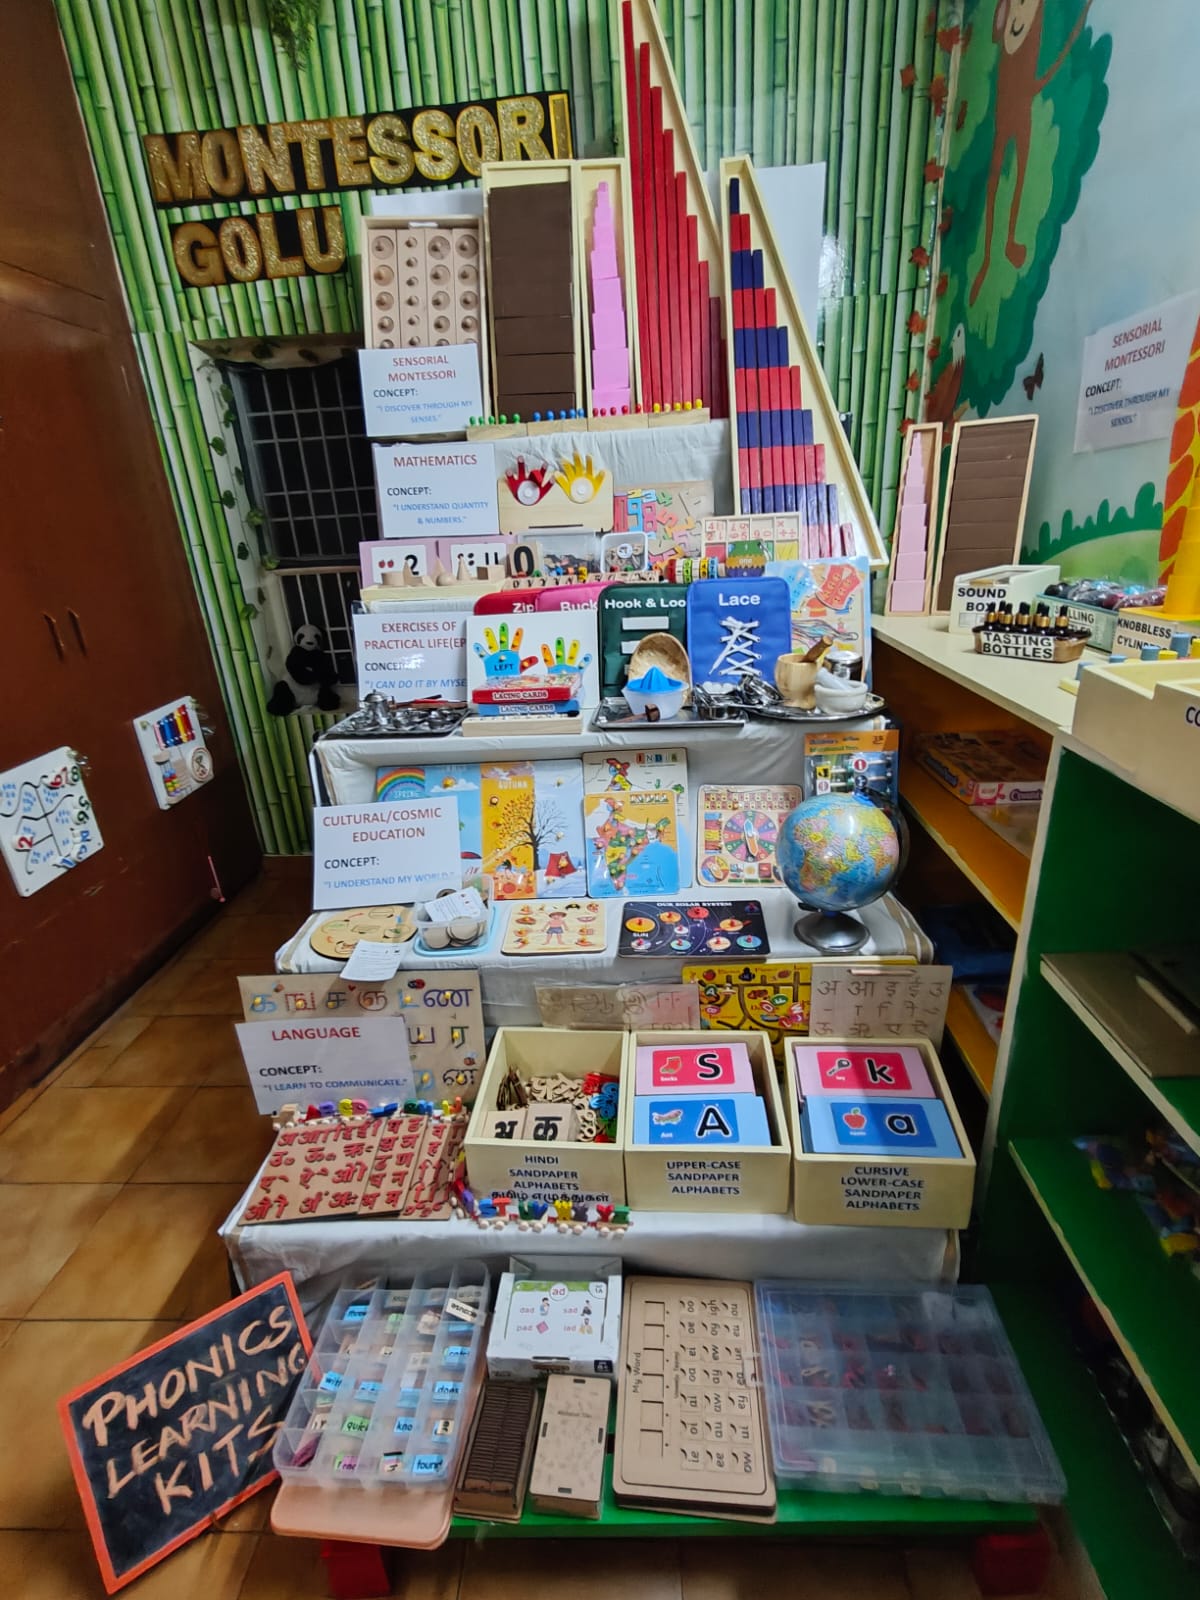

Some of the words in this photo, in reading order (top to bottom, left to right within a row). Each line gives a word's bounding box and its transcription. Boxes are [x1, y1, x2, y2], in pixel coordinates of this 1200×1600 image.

[144, 93, 571, 201] MONTESSORI
[173, 208, 346, 287] GOLU
[1111, 318, 1163, 348] SENSORIAL
[392, 353, 449, 367] SENSORIAL
[1104, 340, 1166, 371] MONTESSORI
[388, 369, 457, 382] MONTESSORI
[373, 388, 418, 398] CONCEPT:
[1085, 378, 1122, 398] CONCEPT:
[393, 454, 478, 467] MATHEMATICS
[387, 486, 432, 496] CONCEPT:
[401, 502, 450, 511] UNDERSTAND
[451, 501, 488, 511] QUANTITY
[405, 554, 420, 576] 2
[513, 546, 534, 578] 0
[957, 587, 1006, 598] SOUND
[560, 599, 598, 611] Buck
[604, 599, 641, 609] Hook
[645, 598, 657, 608] &
[661, 598, 685, 608] Loo
[718, 592, 761, 607] Lace
[512, 602, 535, 613] Zip
[966, 602, 991, 612] BOX
[381, 622, 439, 633] EXERCISES
[442, 621, 457, 632] OF
[1117, 617, 1172, 639] KNOBBLESS
[364, 639, 425, 650] PRACTICAL
[427, 637, 466, 649] LIFE(EP
[983, 631, 1053, 647] TASTING
[982, 643, 1053, 659] BOTTLES
[365, 661, 406, 671] CONCE
[494, 663, 514, 671] LEFT
[375, 680, 396, 689] CAN
[398, 679, 412, 689] DO
[415, 679, 423, 688] IT
[426, 679, 436, 688] BY
[440, 678, 466, 688] MYSE
[322, 807, 442, 827] CULTURAL/COSMIC
[352, 827, 425, 843] EDUCATION
[324, 856, 380, 870] CONCEPT:
[332, 874, 396, 889] UNDERSTAND
[397, 874, 413, 885] MY
[817, 980, 841, 996] अ
[848, 980, 875, 997] आ
[250, 992, 278, 1013] க
[325, 991, 347, 1009] ச
[271, 1026, 360, 1041] LANGUAGE
[259, 1065, 323, 1078] CONCEPT:
[698, 1052, 722, 1080] S
[866, 1058, 894, 1083] k
[275, 1081, 307, 1091] LEARN
[309, 1080, 323, 1089] TO
[533, 1116, 563, 1141] क
[697, 1106, 731, 1138] A
[888, 1115, 916, 1135] a
[524, 1155, 559, 1164] HINDI
[666, 1160, 742, 1170] UPPER-CASE
[509, 1168, 578, 1179] SANDPAPER
[667, 1172, 740, 1182] SANDPAPER
[854, 1166, 909, 1177] CURSIVE
[513, 1181, 579, 1191] ALPHABETS
[840, 1177, 925, 1188] LOWER-CASE
[671, 1185, 740, 1195] ALPHABETS
[844, 1189, 921, 1199] SANDPAPER
[492, 1197, 511, 1217] T
[596, 1203, 615, 1223] Y
[845, 1200, 920, 1211] ALPHABETS
[552, 1286, 565, 1296] ad
[519, 1306, 535, 1314] dad
[516, 1325, 533, 1333] pad
[632, 1352, 641, 1375] Word
[82, 1305, 293, 1447] PHONICS
[632, 1379, 641, 1393] My
[105, 1342, 308, 1500] LEARNING
[155, 1405, 287, 1516] KITS
